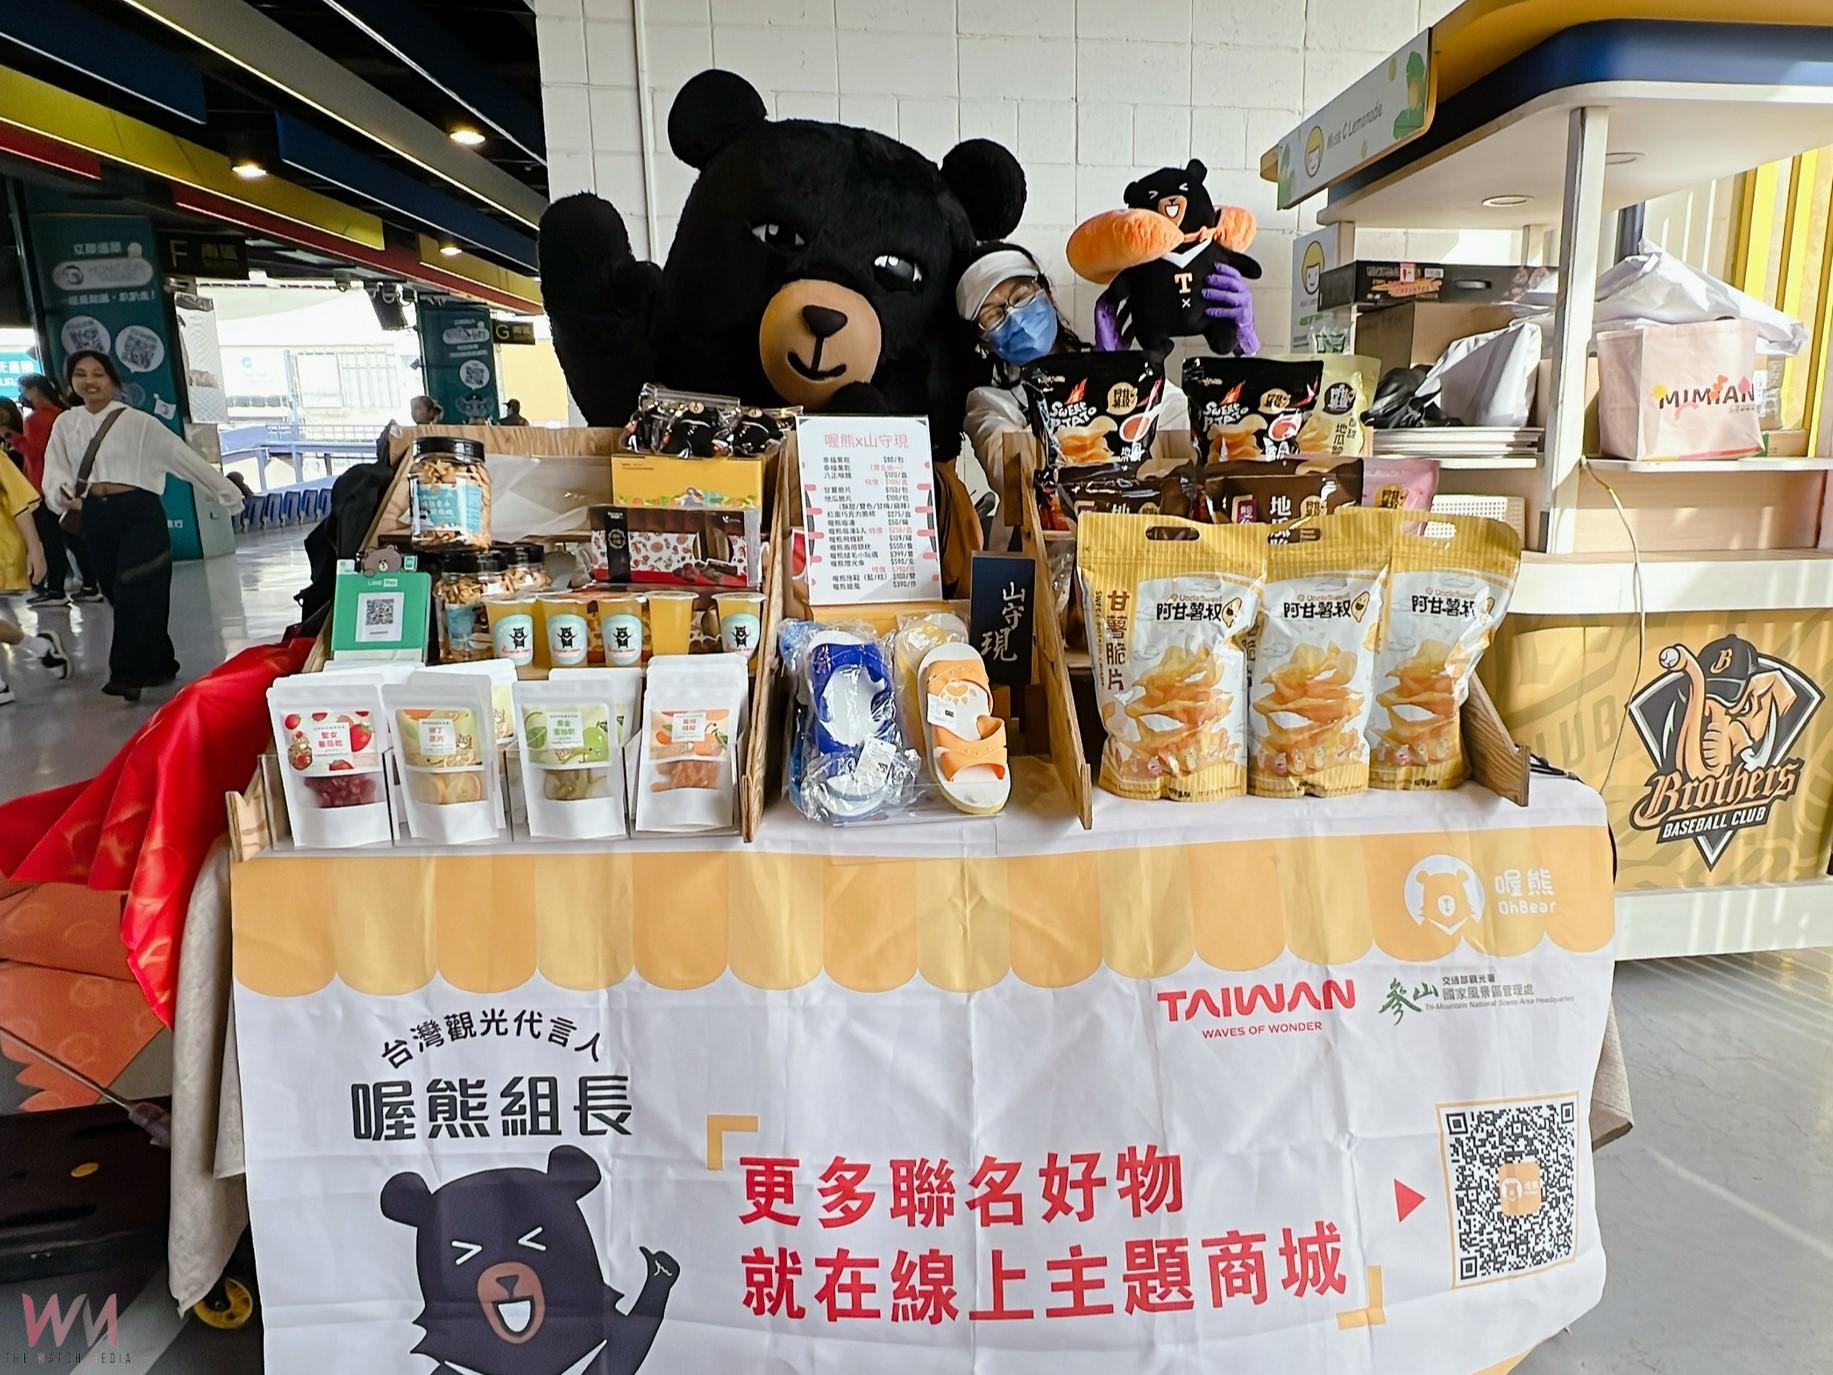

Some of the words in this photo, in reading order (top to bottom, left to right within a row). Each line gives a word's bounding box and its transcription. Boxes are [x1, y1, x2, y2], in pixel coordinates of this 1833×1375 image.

[170, 240, 188, 267] F
[1174, 272, 1193, 294] T
[495, 324, 510, 339] G
[980, 581, 1026, 662] 山守現
[1156, 602, 1223, 621] 阿甘薯叔
[1283, 600, 1351, 618] 阿甘薯叔
[1711, 648, 1733, 673] B
[1634, 762, 1800, 827] Brothers
[1662, 814, 1727, 839] BASEBALL
[1731, 806, 1767, 825] CLUB
[1495, 868, 1555, 896] 喔熊
[1498, 900, 1557, 914] OhBear
[1157, 978, 1356, 1022] TAIWAN
[1442, 984, 1534, 1000] 國家風景區管理處
[381, 1008, 600, 1069] 台灣觀光代言人
[1202, 1027, 1245, 1040] WAVES
[1248, 1025, 1265, 1036] OF
[1268, 1021, 1323, 1035] WONDER
[351, 1075, 633, 1140] 喔熊組長
[738, 1144, 1183, 1228] 更多聯名好物
[740, 1220, 1347, 1325] 就在線上主題商城
